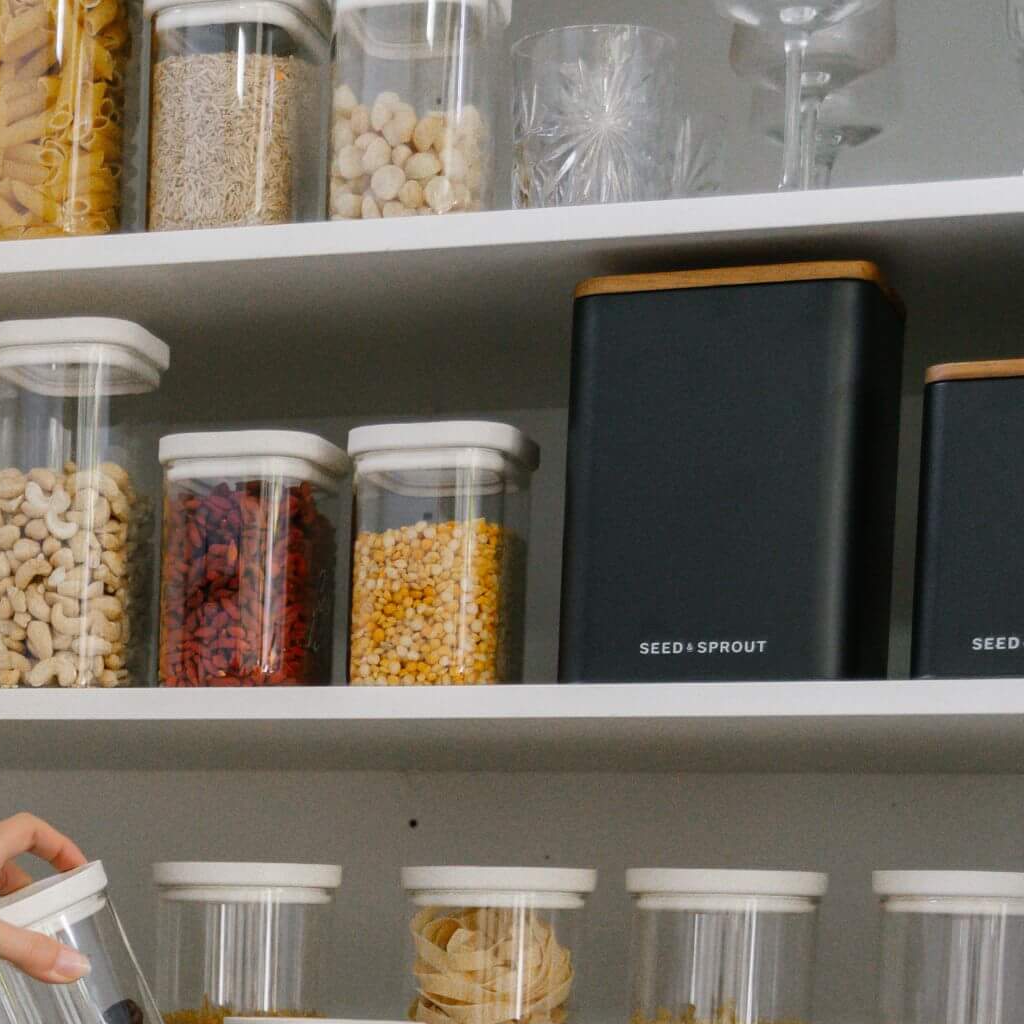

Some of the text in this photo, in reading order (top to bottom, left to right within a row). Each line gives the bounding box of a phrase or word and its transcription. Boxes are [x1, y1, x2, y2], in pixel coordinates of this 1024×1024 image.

[639, 641, 684, 655] SEED
[697, 640, 768, 654] SPROUT
[971, 636, 1021, 651] SEED
